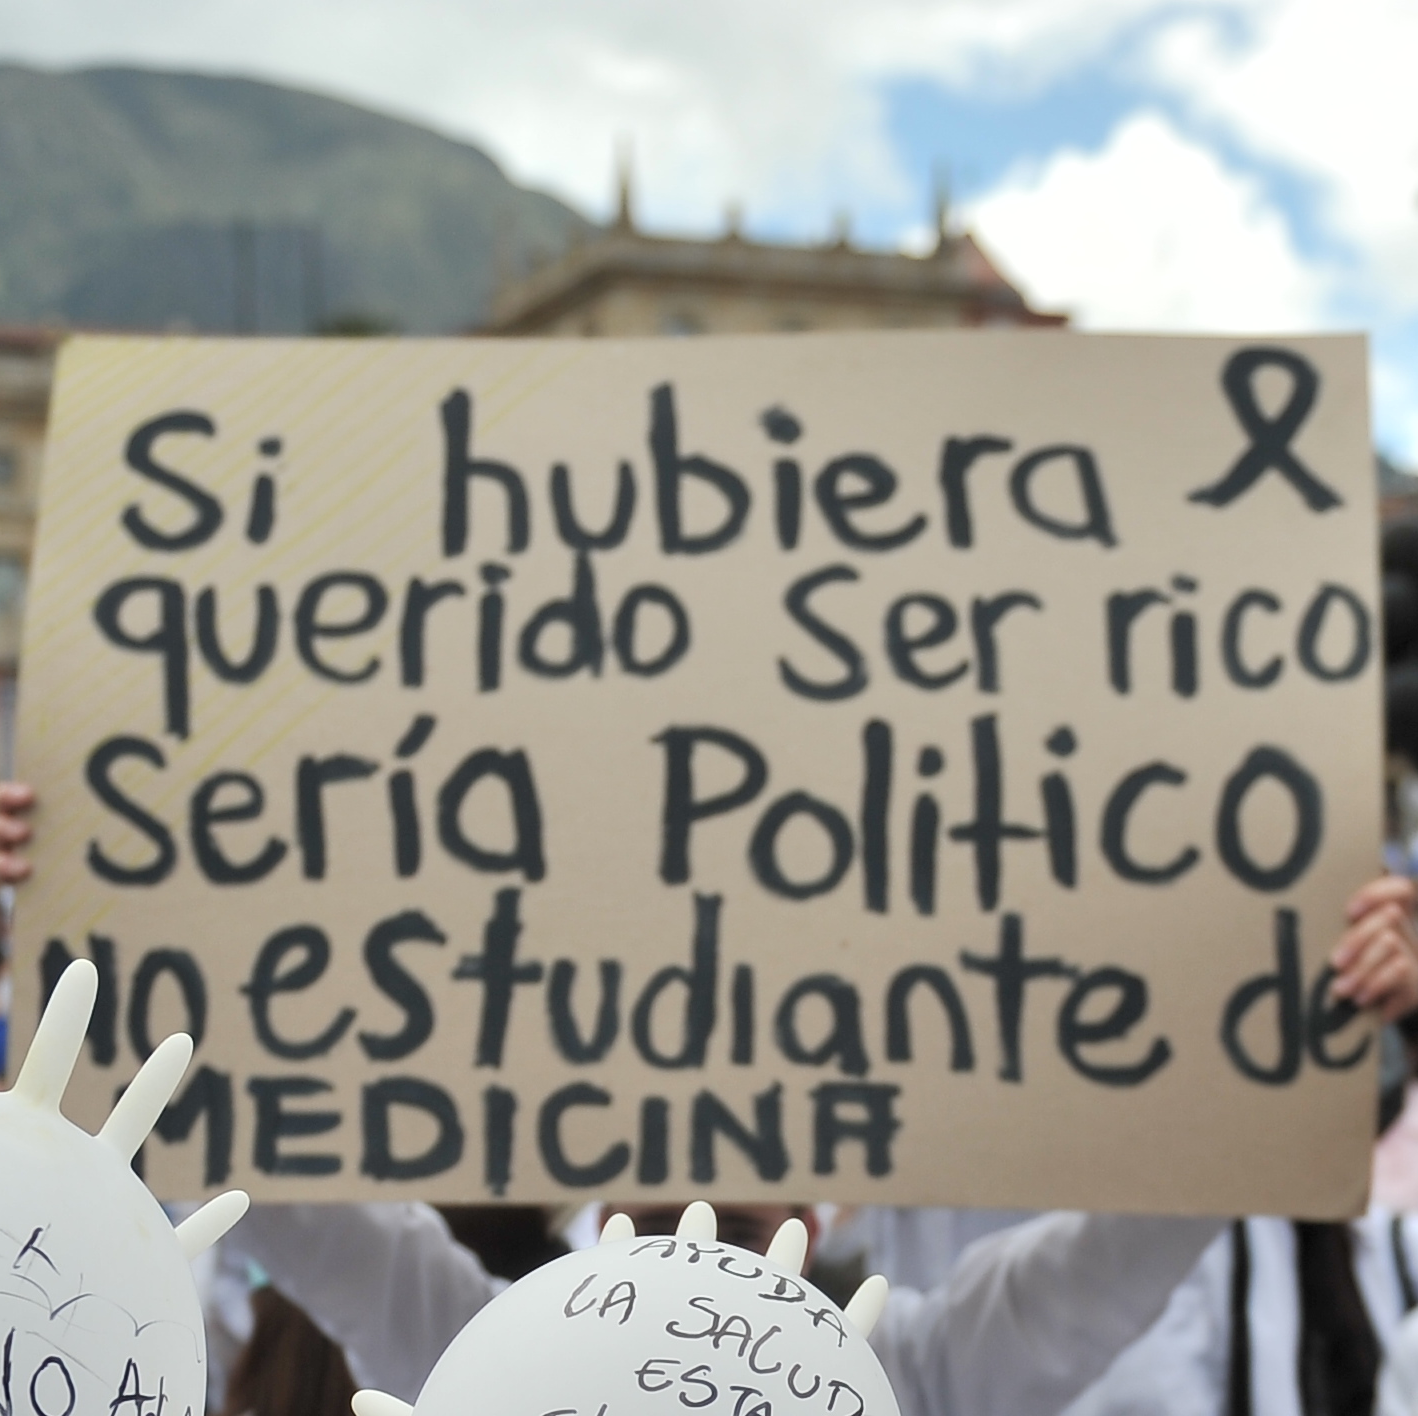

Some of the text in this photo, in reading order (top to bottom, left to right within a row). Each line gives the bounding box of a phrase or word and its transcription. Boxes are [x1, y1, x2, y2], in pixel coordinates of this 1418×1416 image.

[120, 383, 1118, 557] Si hubiera
[93, 550, 691, 742] querido
[1106, 576, 1373, 698] rico
[651, 714, 1323, 915] Politico
[237, 888, 1175, 1088] estudiante
[1218, 906, 1374, 1087] de
[113, 1063, 903, 1197] MEDICINA
[562, 1272, 637, 1326] LA
